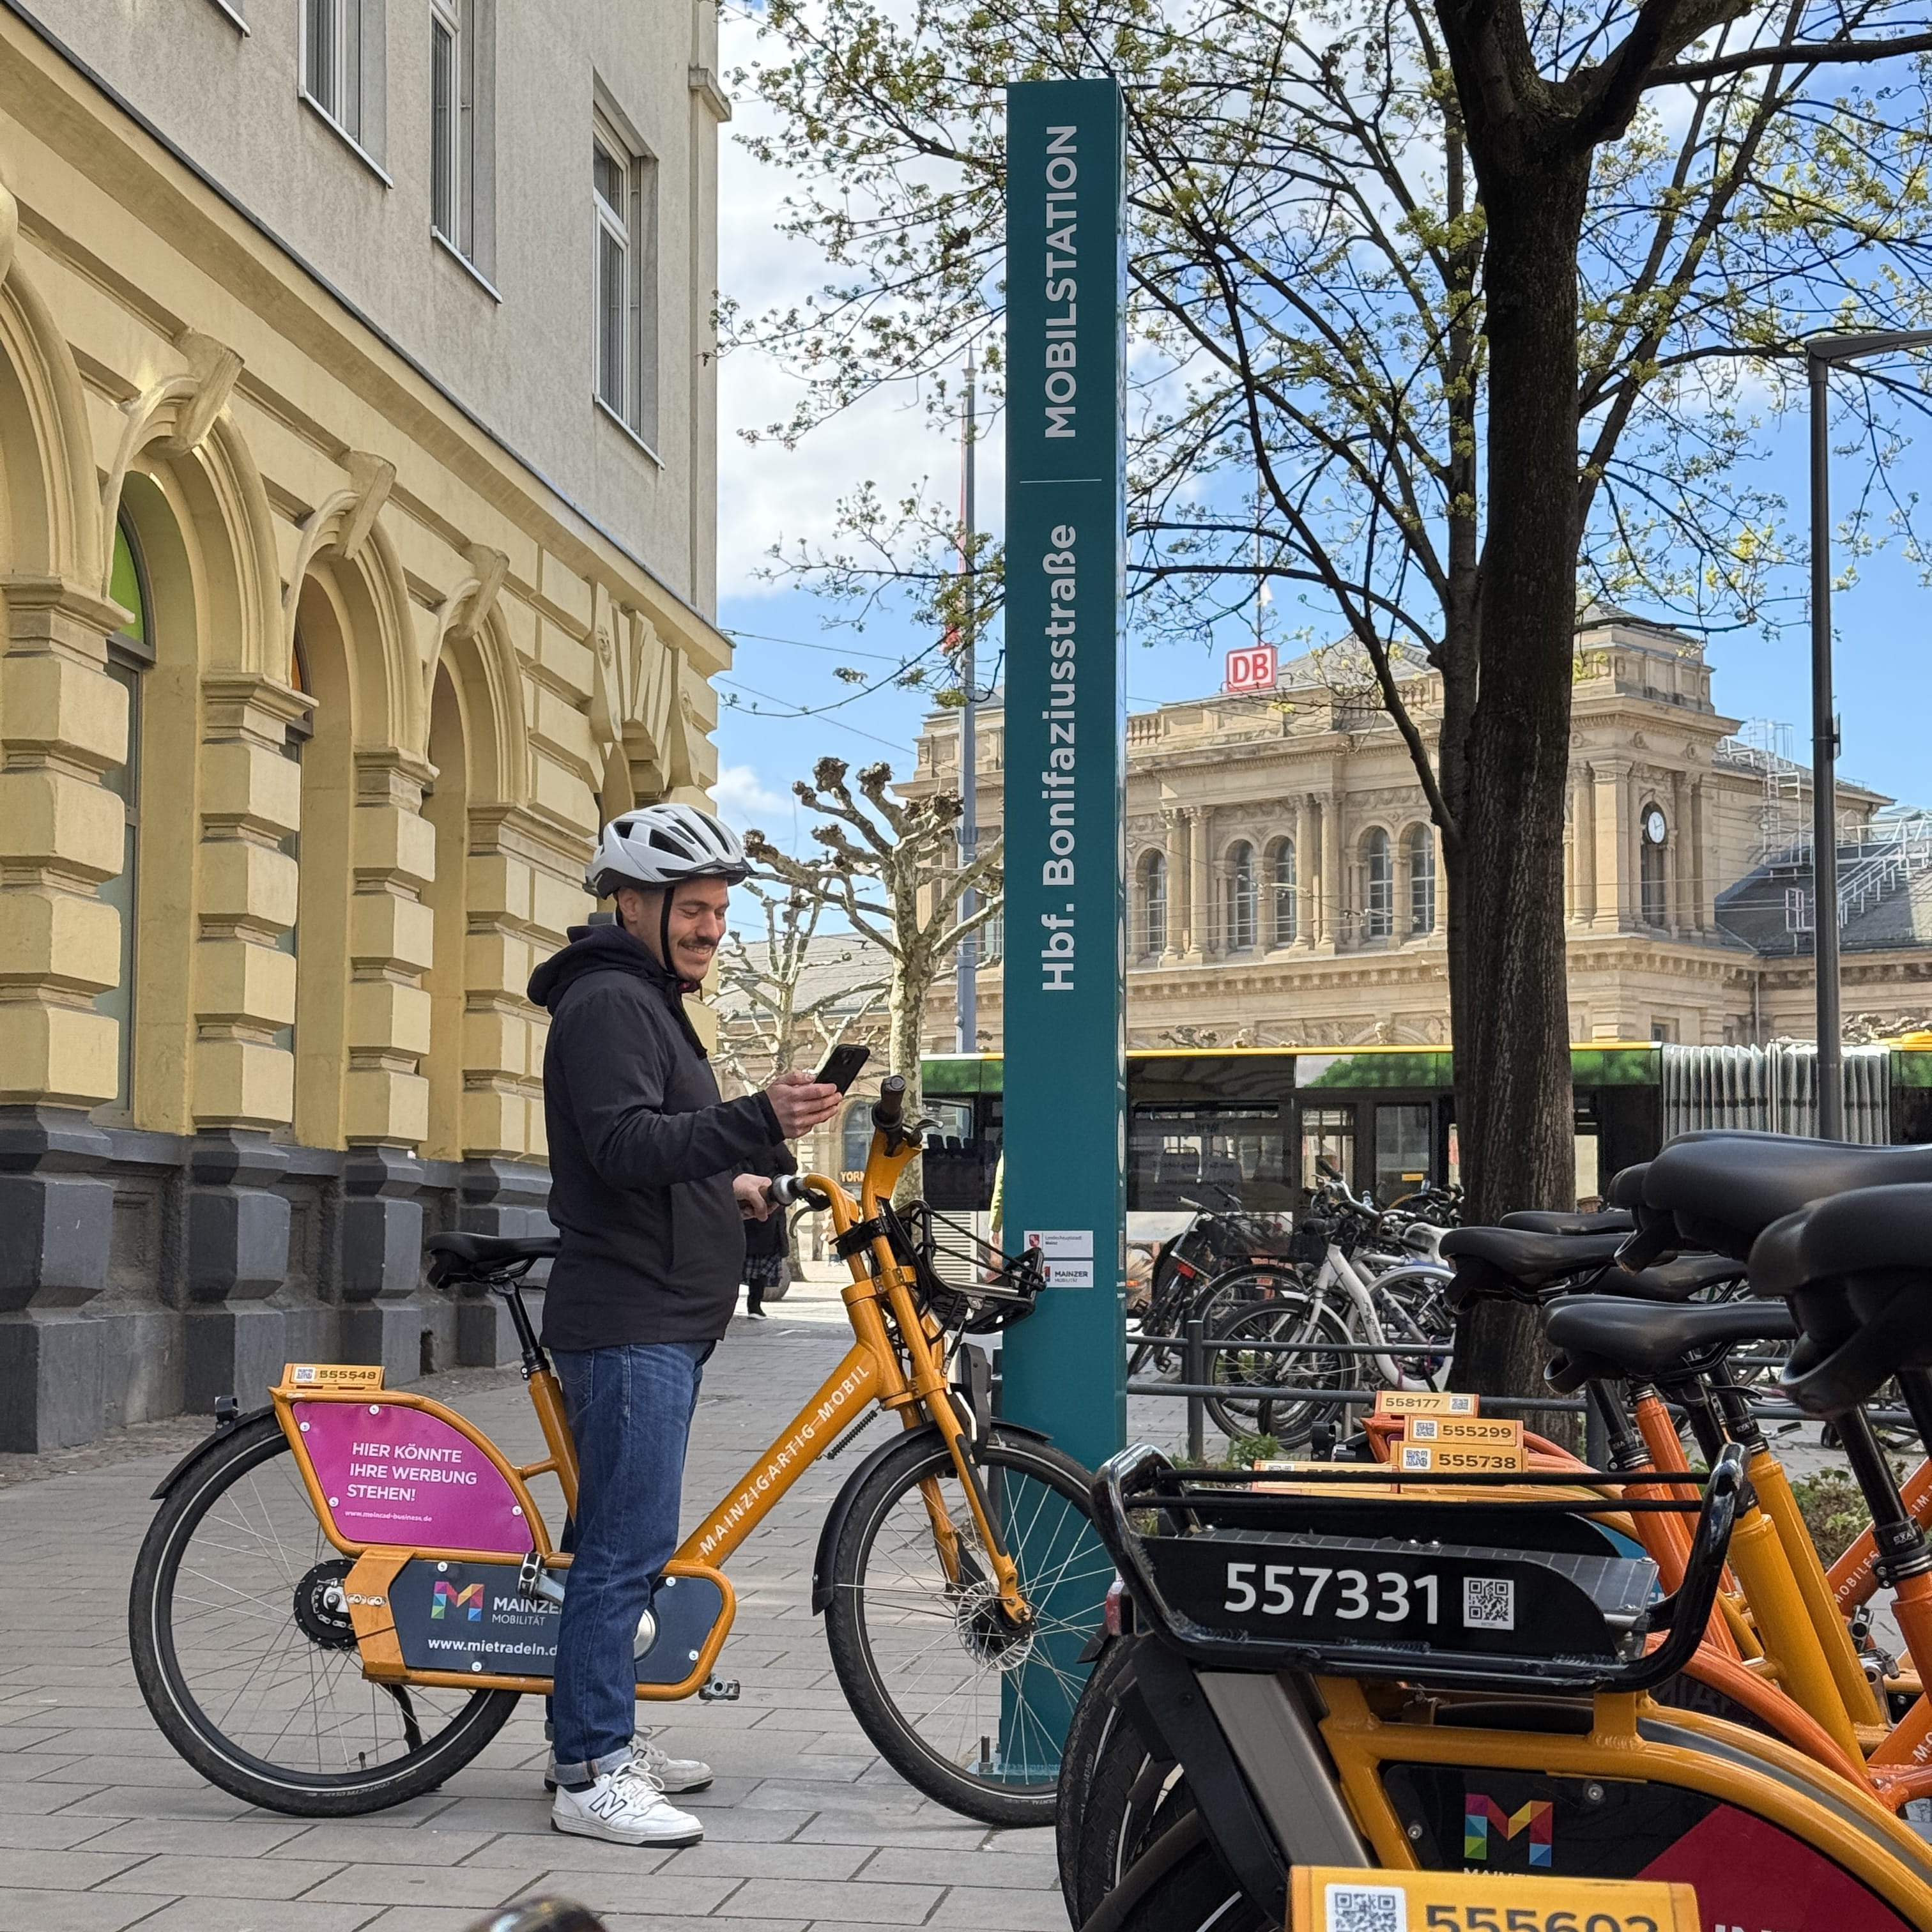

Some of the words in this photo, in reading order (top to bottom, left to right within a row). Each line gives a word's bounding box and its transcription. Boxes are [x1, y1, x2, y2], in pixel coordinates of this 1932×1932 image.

[1045, 125, 1077, 438] MOBILSTATION
[1233, 654, 1269, 683] DB
[1041, 525, 1077, 885] Bonifaziusstraße
[1041, 903, 1075, 990] Hbf.
[1442, 1425, 1512, 1438] 555299
[352, 1442, 390, 1457] HIER
[394, 1443, 463, 1463] KÖNNTE
[700, 1423, 815, 1556] MAINZIGARTIG
[817, 1365, 870, 1422] MOBIL
[1439, 1453, 1517, 1469] 555738
[349, 1462, 388, 1478] IHRE
[392, 1466, 477, 1485] WERBUNG
[346, 1483, 416, 1501] STEHEN!
[1224, 1562, 1438, 1625] 557331
[493, 1597, 562, 1615] MAINZE
[491, 1614, 546, 1626] MOBILITÄT
